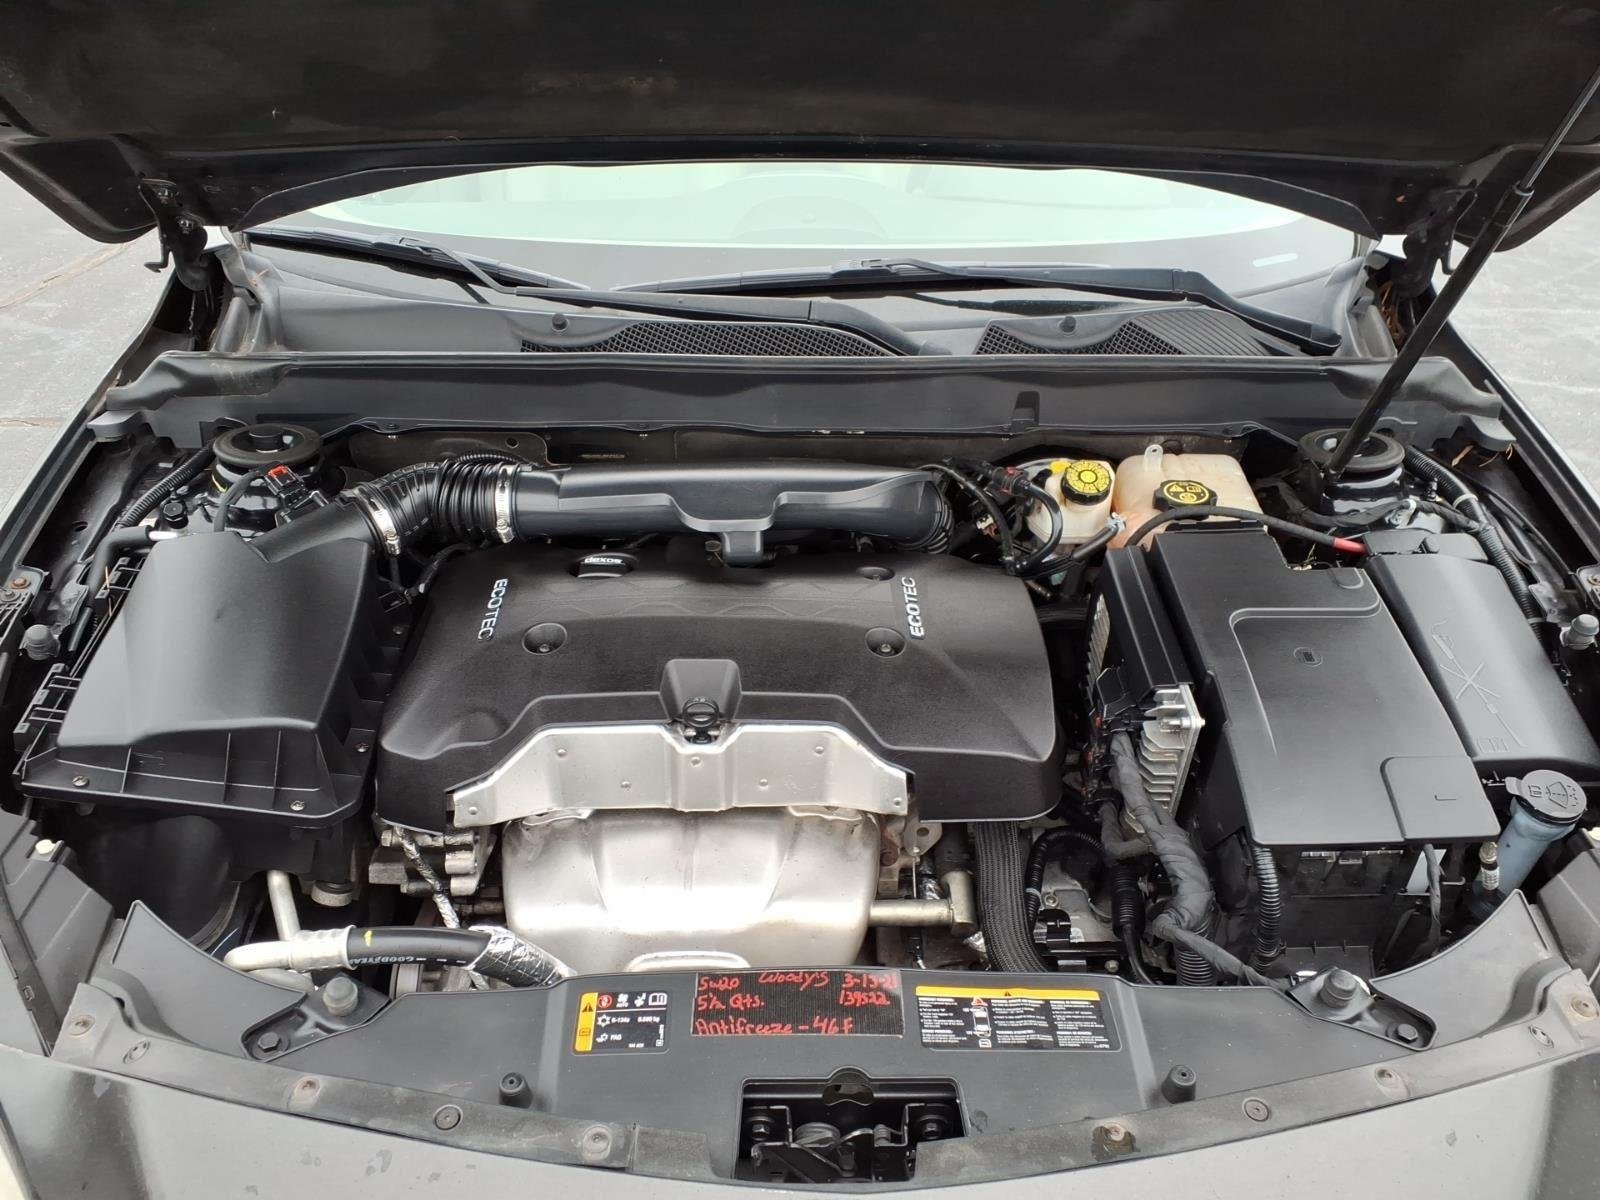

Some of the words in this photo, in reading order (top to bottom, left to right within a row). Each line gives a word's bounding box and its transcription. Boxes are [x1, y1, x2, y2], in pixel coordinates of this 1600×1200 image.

[584, 556, 624, 564] dexos
[477, 578, 509, 641] ECOTEC
[901, 576, 925, 638] ECOTEC
[758, 971, 829, 991] Woody's
[695, 1015, 793, 1035] Antifreeze
